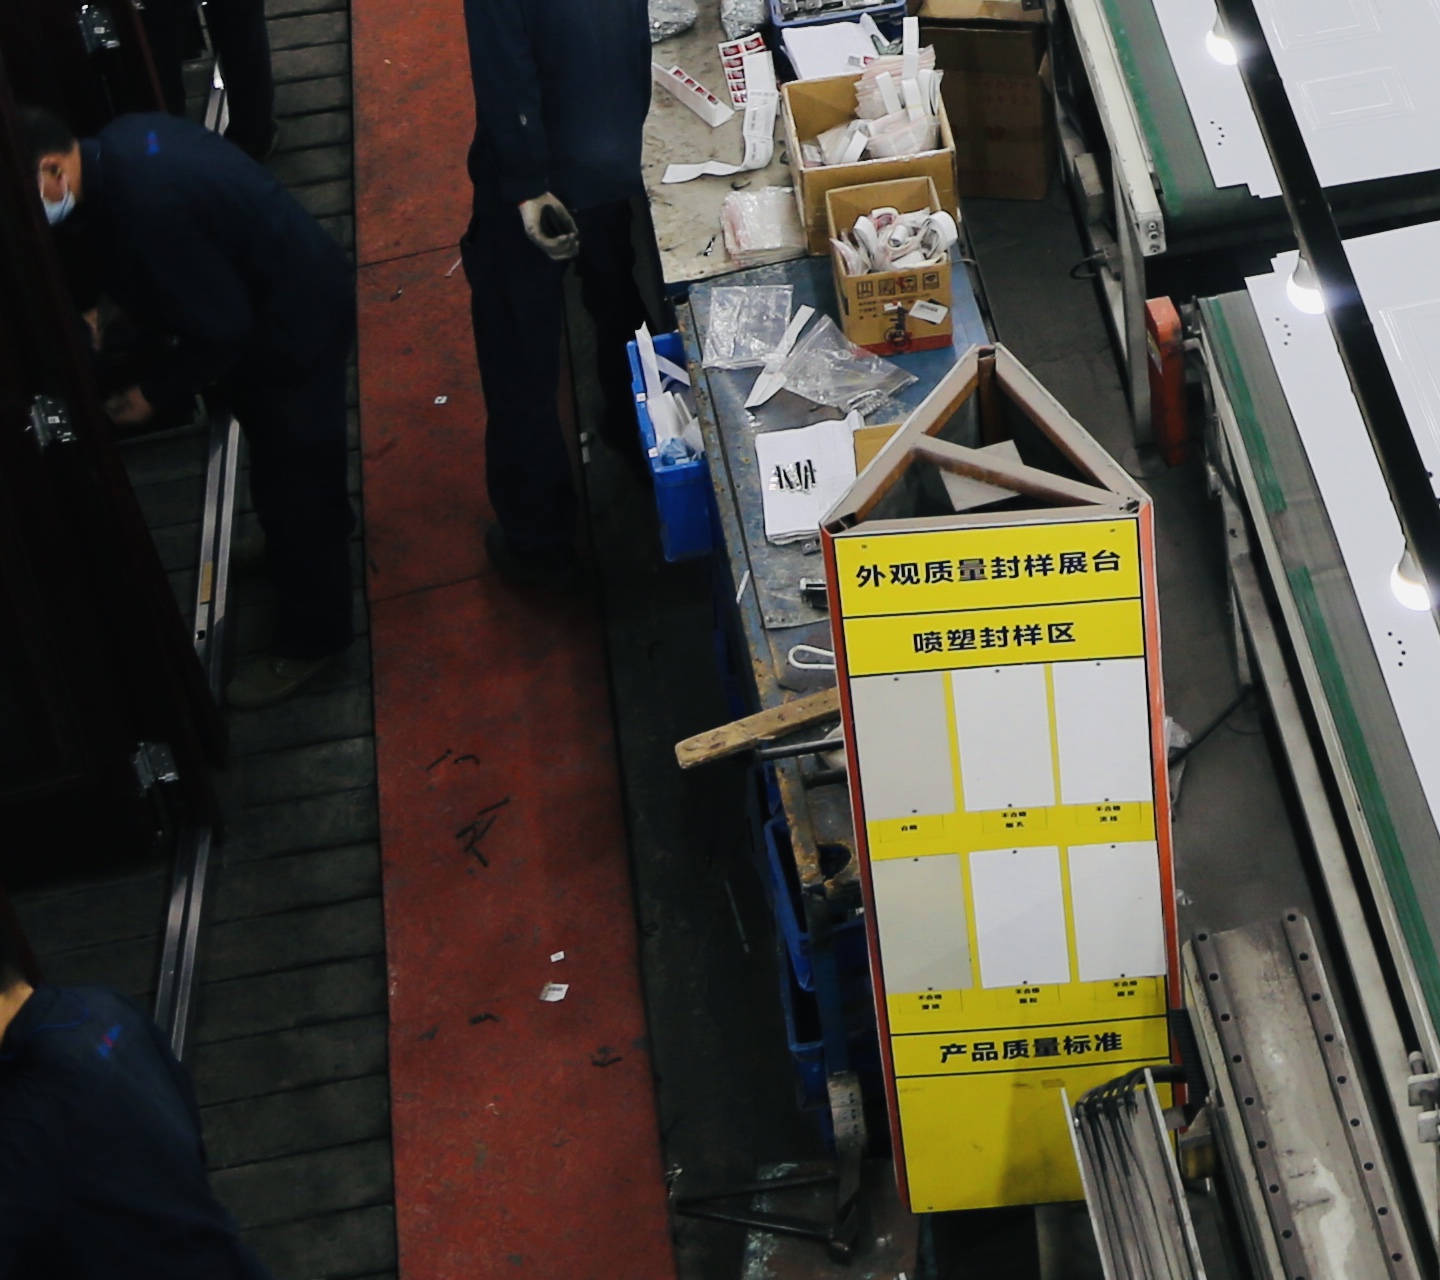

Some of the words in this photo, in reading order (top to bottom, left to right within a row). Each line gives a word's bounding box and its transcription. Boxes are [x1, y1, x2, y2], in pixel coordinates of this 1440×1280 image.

[855, 549, 1121, 588] 外观质量封样展台
[913, 621, 1077, 655] 喷塑封样区
[939, 1032, 1124, 1065] 产品质量标准
